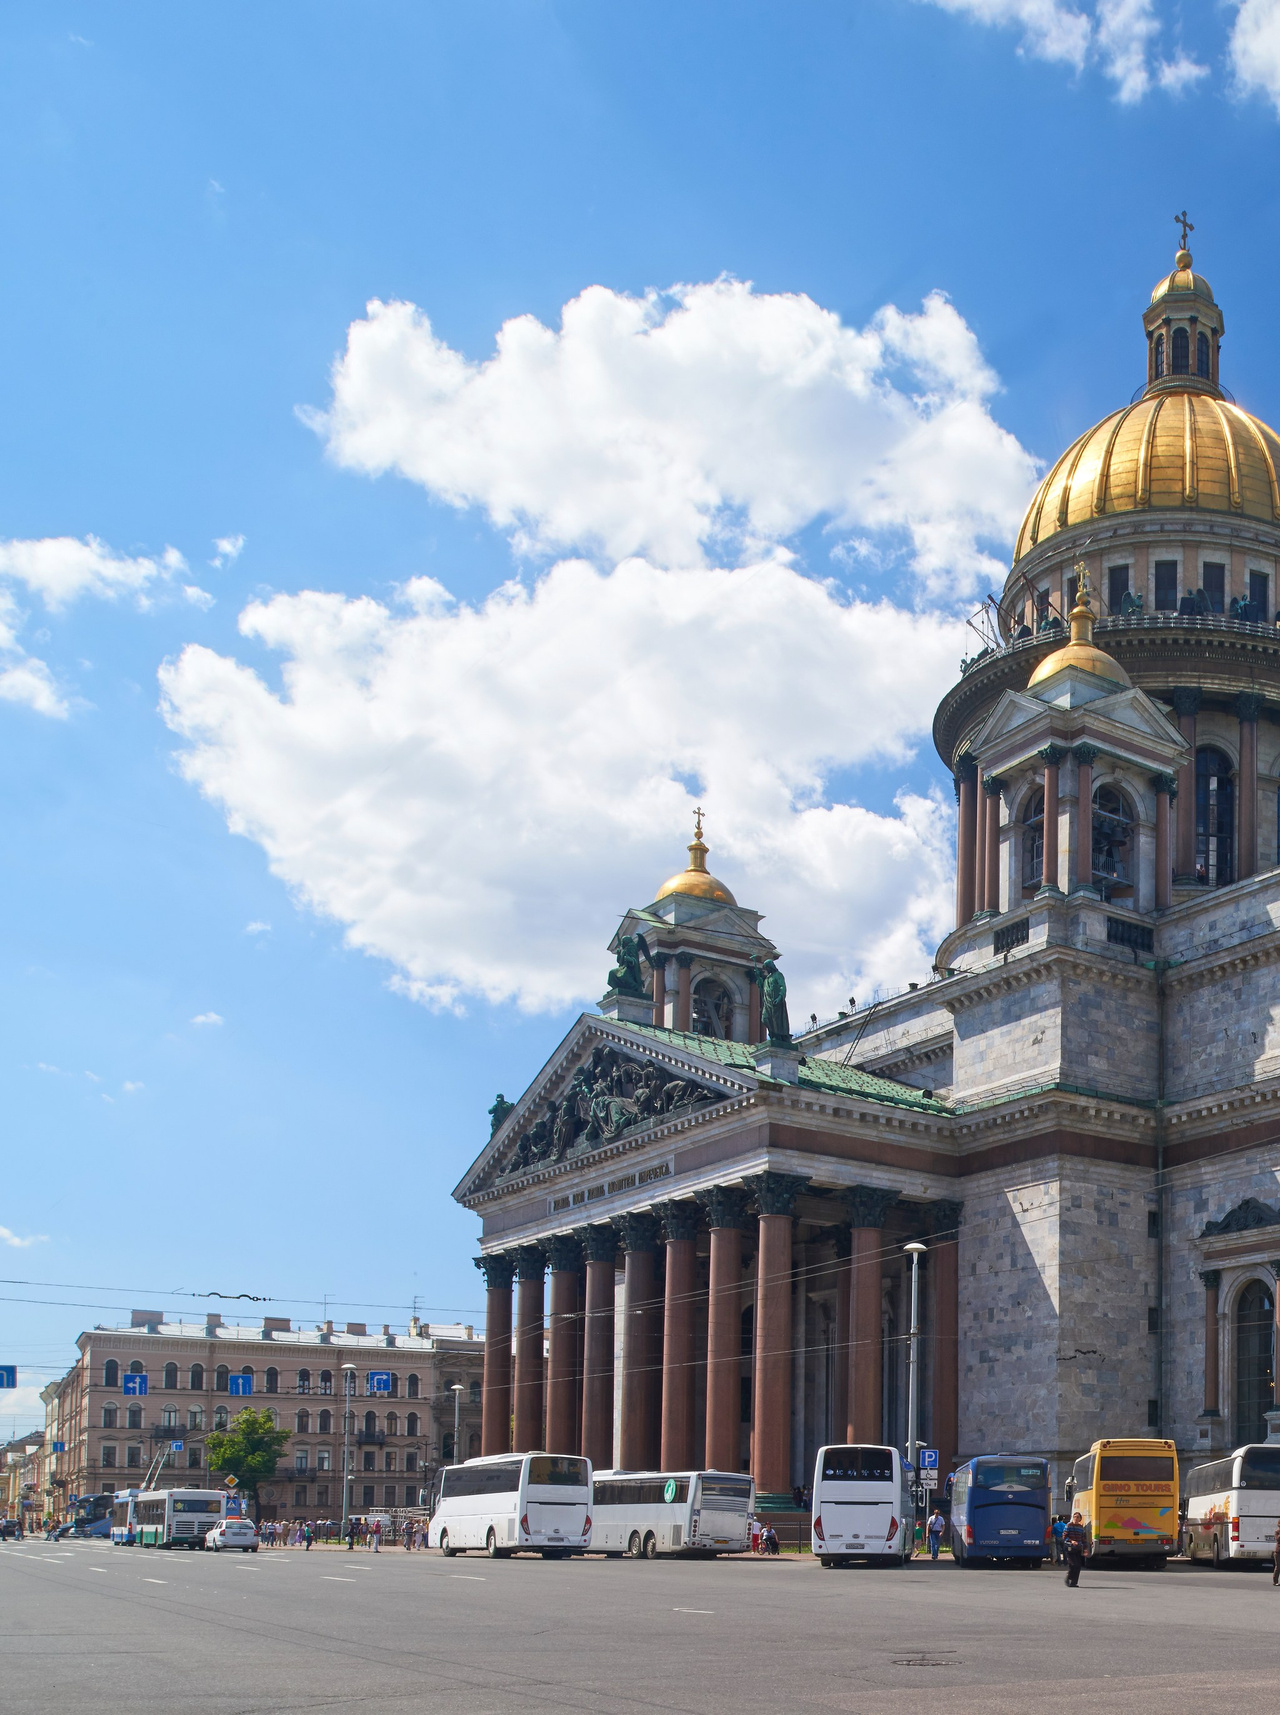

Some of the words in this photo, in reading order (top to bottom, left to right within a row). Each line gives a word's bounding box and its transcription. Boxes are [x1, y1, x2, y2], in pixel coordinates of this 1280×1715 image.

[925, 1451, 935, 1466] P
[1102, 1483, 1131, 1492] GINO
[1134, 1483, 1171, 1492] TOURS
